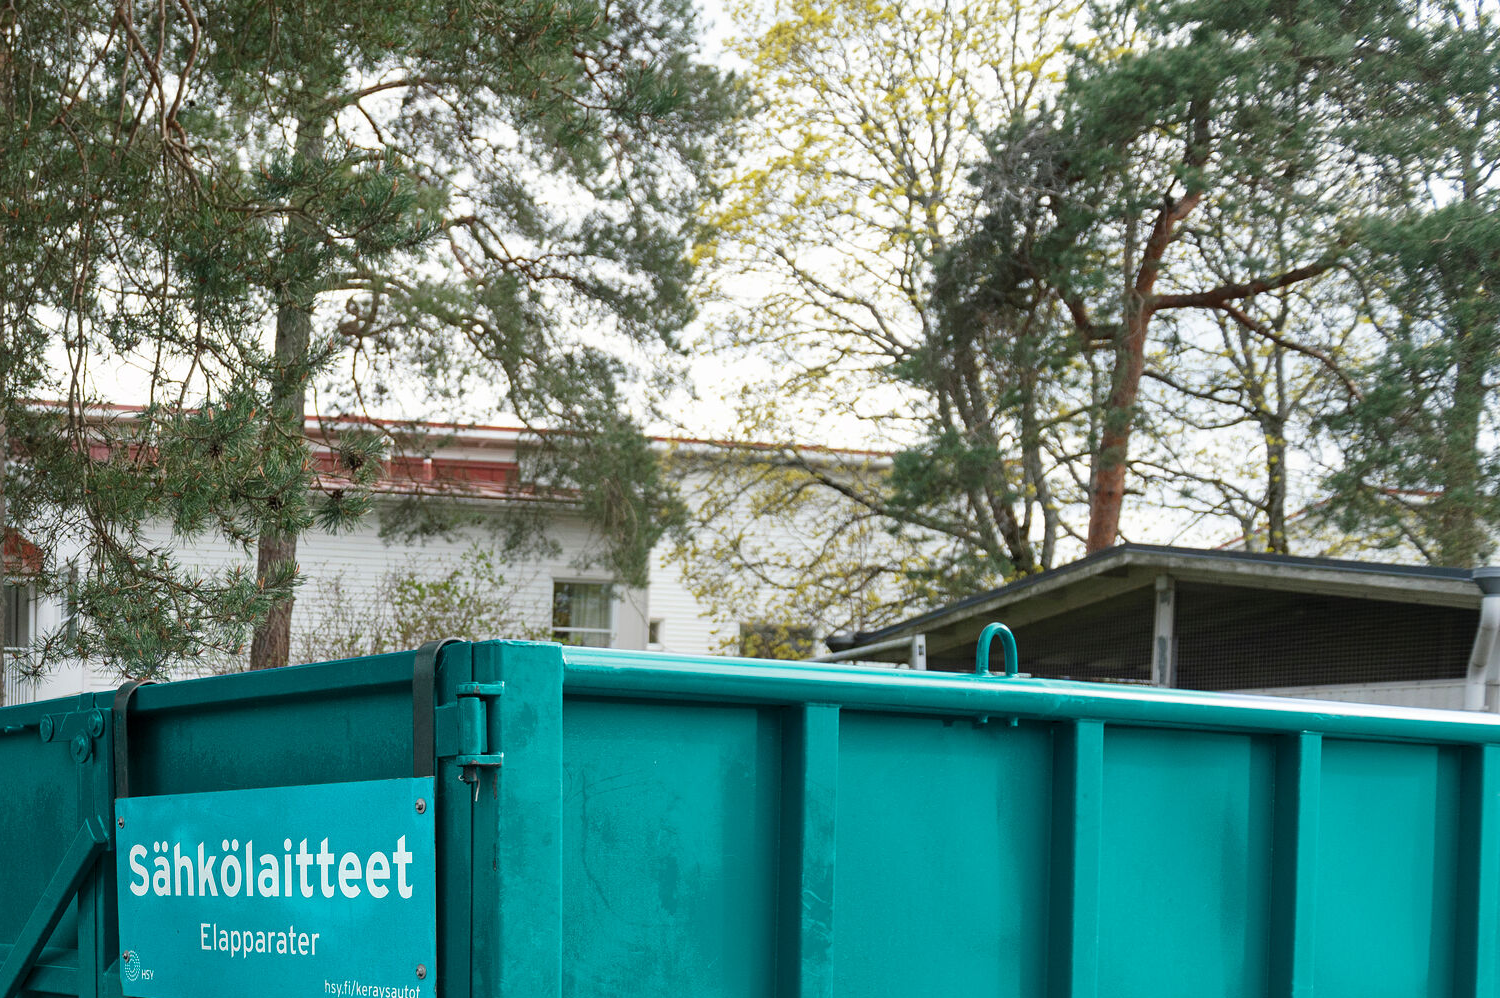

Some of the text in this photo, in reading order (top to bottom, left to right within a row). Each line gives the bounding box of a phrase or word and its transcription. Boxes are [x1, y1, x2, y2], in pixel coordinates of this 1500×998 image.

[129, 834, 413, 899] Sähkölaitteet
[200, 923, 320, 958] Elapparater
[141, 969, 154, 980] HSY
